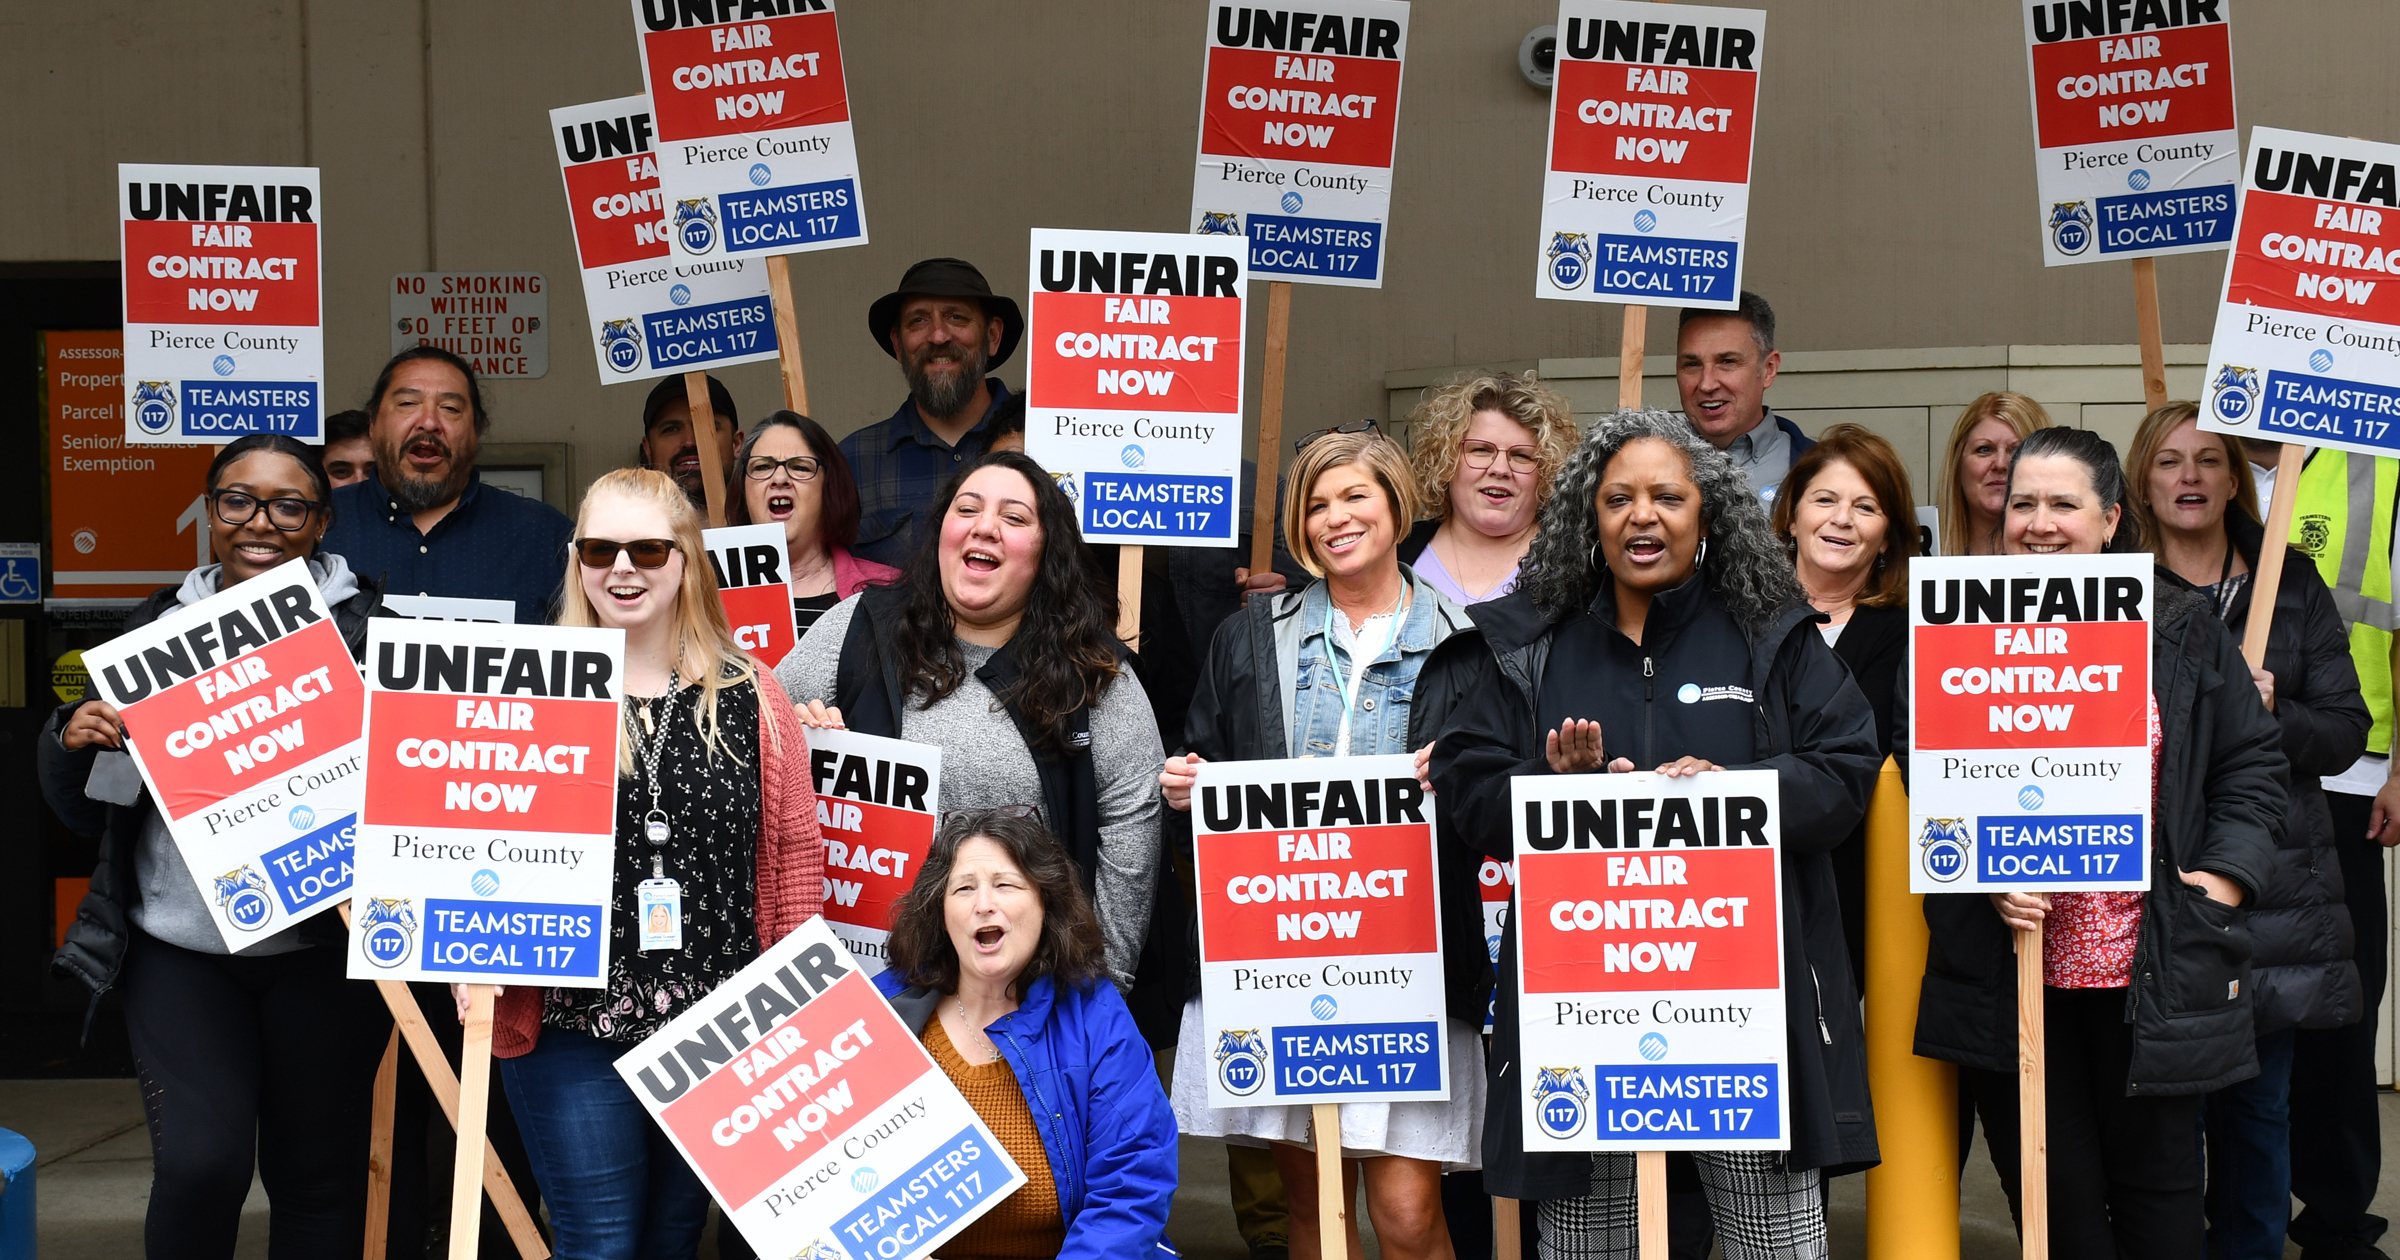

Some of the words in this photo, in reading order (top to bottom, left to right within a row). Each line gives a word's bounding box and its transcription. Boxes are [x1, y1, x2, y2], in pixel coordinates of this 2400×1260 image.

[1217, 6, 1400, 59] UNFAIR
[2033, 0, 2221, 43] UNFAIR
[710, 24, 773, 52] FAIR
[1566, 17, 1756, 70] UNFAIR
[2100, 35, 2162, 63] FAIR
[672, 52, 820, 91] CONTRACT
[1274, 55, 1335, 83] FAIR
[1626, 67, 1689, 95] FAIR
[2057, 62, 2209, 100] CONTRACT
[715, 90, 785, 121] NOW
[1227, 85, 1377, 119] CONTRACT
[1578, 99, 1732, 133] CONTRACT
[2099, 98, 2170, 128] NOW
[1263, 121, 1335, 149] NOW
[684, 143, 748, 166] Pierce
[755, 134, 831, 158] County
[1615, 136, 1689, 164] NOW
[2064, 148, 2128, 170] Pierce
[2137, 142, 2214, 164] County
[1221, 162, 1285, 185] Pierce
[1294, 168, 1368, 195] County
[2254, 147, 2400, 208] UNFA
[129, 182, 312, 223] UNFAIR
[727, 188, 848, 220] TEAMSTERS
[1572, 179, 1638, 203] Pierce
[1647, 184, 1724, 212] County
[2104, 194, 2228, 222] TEAMSTERS
[732, 220, 801, 246] LOCAL
[807, 215, 839, 236] 117
[2107, 224, 2177, 247] LOCAL
[2185, 220, 2217, 239] 117
[2314, 203, 2382, 236] FAIR
[192, 224, 252, 248] FAIR
[687, 229, 707, 243] 117
[1253, 222, 1372, 249] TEAMSTERS
[2061, 232, 2082, 243] 117
[1251, 248, 1318, 270] LOCAL
[1327, 253, 1359, 272] 117
[1605, 243, 1729, 269] TEAMSTERS
[2260, 232, 2400, 275] CONTRAC
[148, 256, 297, 281] CONTRACT
[607, 265, 668, 289] Pierce
[1040, 249, 1239, 298] UNFAIR
[1557, 265, 1579, 277] 117
[1603, 269, 1673, 291] LOCAL
[1682, 274, 1715, 294] 117
[397, 277, 425, 294] NO
[442, 276, 541, 294] SMOKING
[2295, 273, 2376, 306] NOW
[188, 288, 258, 311] NOW
[431, 297, 507, 314] WITHIN
[1104, 298, 1170, 325] FAIR
[444, 317, 496, 334] FEET
[651, 305, 765, 338] TEAMSTERS
[2246, 313, 2316, 342] Pierce
[150, 330, 215, 350] Pierce
[224, 331, 299, 355] County
[614, 348, 633, 360] 117
[656, 339, 721, 362] LOCAL
[727, 331, 757, 350] 117
[1055, 332, 1218, 362] CONTRACT
[472, 357, 528, 375] ANCE
[61, 372, 125, 391] Propert
[1097, 369, 1174, 396] NOW
[61, 404, 113, 420] Parcel
[189, 389, 310, 408] TEAMSTERS
[2221, 398, 2245, 412] 117
[144, 410, 165, 422] 117
[190, 412, 259, 431] LOCAL
[266, 414, 299, 431] 117
[1054, 415, 1124, 438] Pierce
[1134, 418, 1215, 444] County
[2269, 407, 2343, 436] LOCAL
[2353, 419, 2390, 441] 117
[63, 456, 155, 475] Exemption
[1093, 481, 1224, 505] TEAMSTERS
[1093, 509, 1167, 530] LOCAL
[1175, 511, 1211, 531] 117
[93, 609, 132, 620] ALLOWE
[1920, 576, 2144, 625] UNFAIR
[101, 584, 321, 705] UNFAIR
[1994, 627, 2068, 655] FAIR
[52, 675, 87, 684] CAUTI
[196, 656, 272, 705] FAIR
[378, 642, 613, 699] UNFAIR
[1941, 665, 2123, 695] CONTRACT
[165, 665, 336, 758] CONTRACT
[456, 699, 534, 731] FAIR
[1988, 704, 2074, 733] NOW
[224, 719, 305, 776] NOW
[396, 738, 590, 775] CONTRACT
[811, 748, 929, 812] FAIR
[1943, 757, 2020, 780] Pierce
[2031, 756, 2122, 781] County
[204, 789, 281, 836] Pierce
[287, 755, 361, 797] Count
[445, 781, 537, 814] NOW
[1202, 777, 1426, 832] UNFAIR
[1525, 796, 1769, 850] UNFAIR
[1986, 825, 2134, 848] TEAMSTERS
[392, 834, 475, 862] Pierce
[488, 838, 584, 870] County
[1278, 832, 1352, 862] FAIR
[1932, 853, 1959, 867] 117
[1606, 856, 1688, 887] FAIR
[1987, 854, 2071, 877] LOCAL
[2079, 853, 2120, 875] 117
[287, 855, 354, 904] LOCA
[1227, 869, 1408, 904] CONTRACT
[236, 899, 260, 919] 117
[1549, 897, 1748, 931] CONTRACT
[434, 910, 592, 938] TEAMSTERS
[1277, 911, 1362, 941] NOW
[373, 937, 401, 952] 117
[433, 942, 522, 967] LOCAL
[533, 945, 576, 969] 117
[1604, 942, 1697, 973] NOW
[1233, 969, 1311, 991] Pierce
[1322, 965, 1413, 989] County
[637, 942, 849, 1104] UNFAIR
[1555, 1002, 1640, 1025] Pierce
[1652, 1000, 1752, 1027] County
[731, 1025, 808, 1087] FAIR
[1281, 1033, 1429, 1058] TEAMSTERS
[711, 1018, 873, 1147] CONTRACT
[1229, 1067, 1255, 1081] 117
[1285, 1064, 1369, 1088] LOCAL
[1377, 1063, 1416, 1084] 117
[1606, 1075, 1768, 1099] TEAMSTERS
[772, 1079, 854, 1152] NOW
[1547, 1108, 1575, 1122] 117
[1608, 1109, 1700, 1133] LOCAL
[1710, 1108, 1753, 1131] 117
[763, 1160, 841, 1218] Pierce
[842, 1096, 927, 1159] County
[844, 1140, 981, 1244] TEAMSTERS
[945, 1170, 984, 1212] 117
